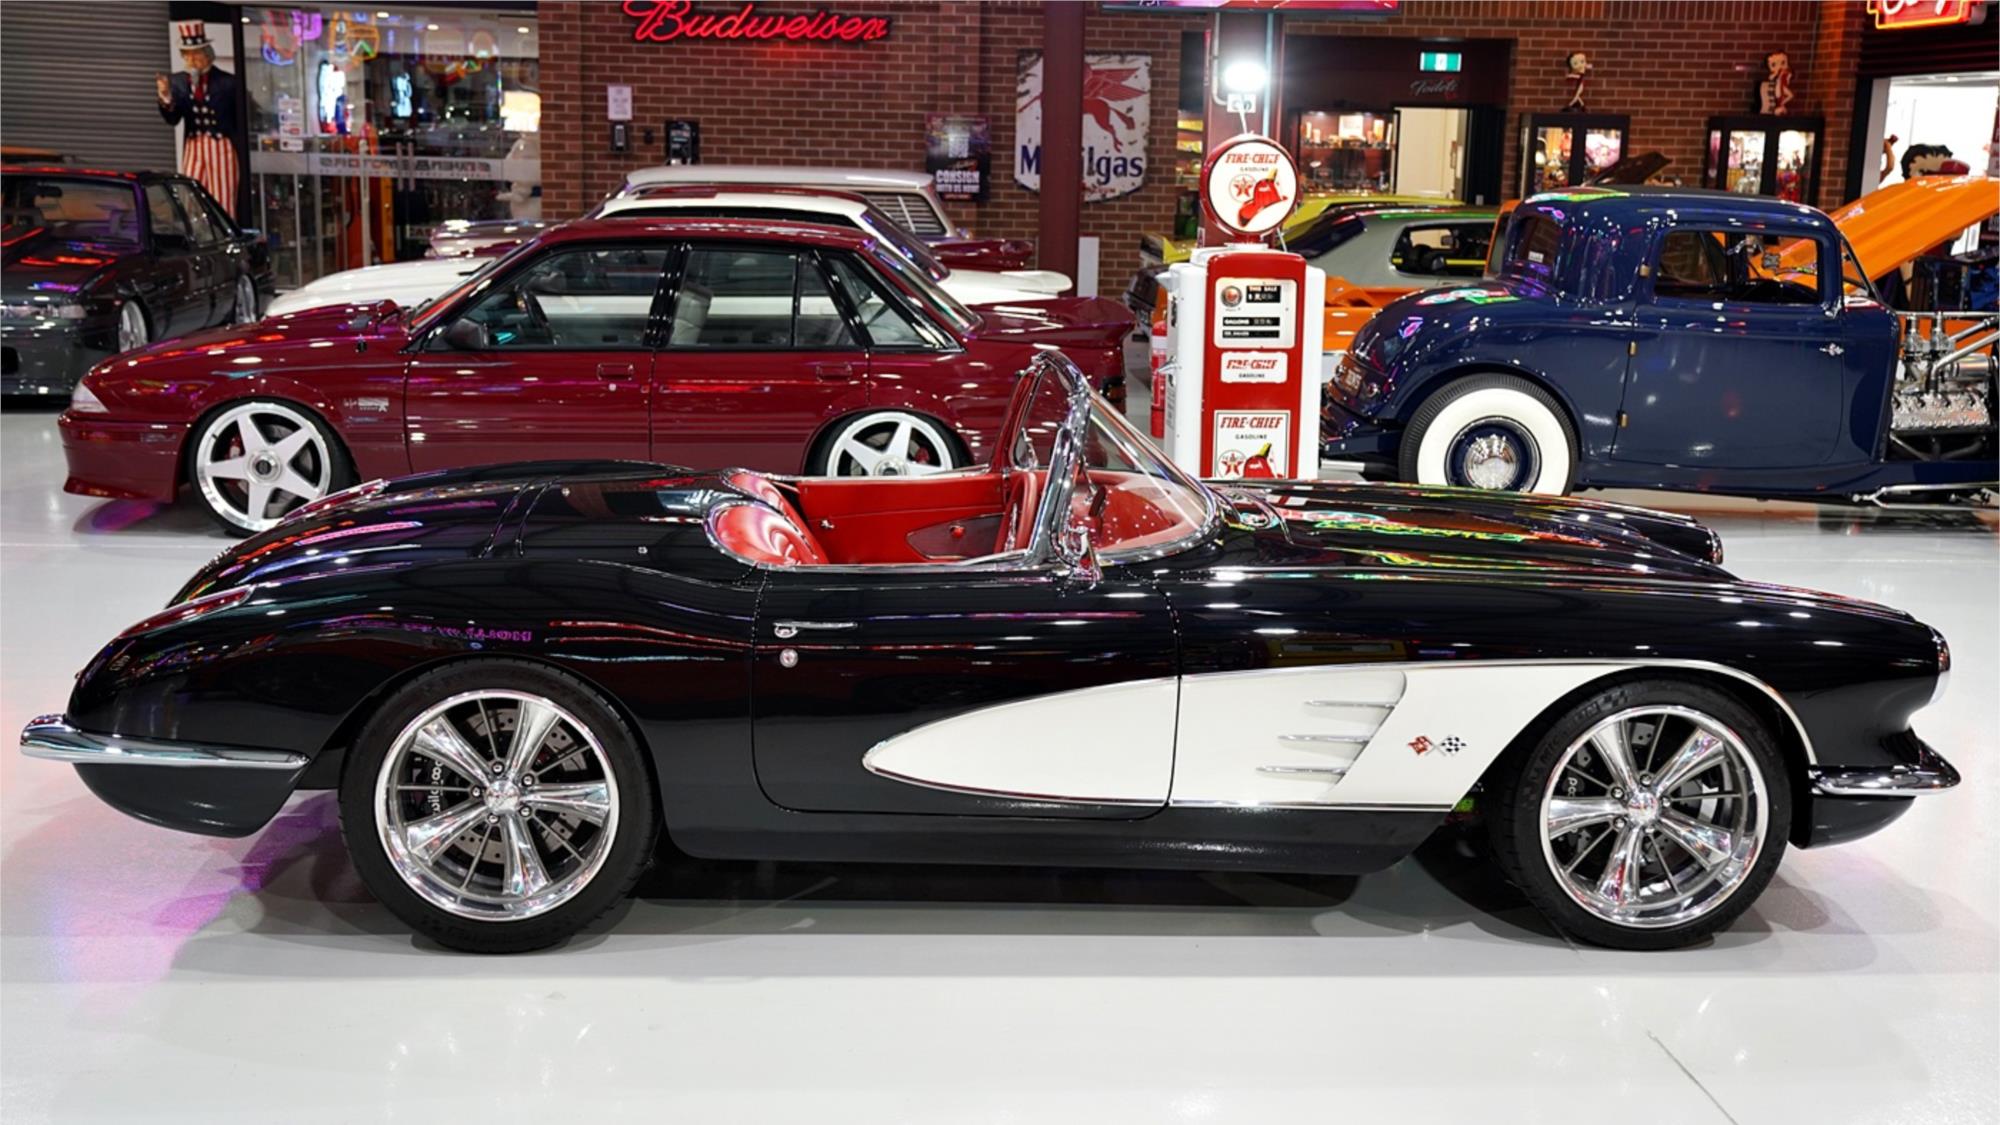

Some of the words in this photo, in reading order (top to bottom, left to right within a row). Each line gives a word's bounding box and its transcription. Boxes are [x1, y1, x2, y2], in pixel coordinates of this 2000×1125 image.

[623, 0, 887, 41] Budweiser
[936, 169, 980, 183] CONSIGN
[1220, 416, 1283, 429] FIRE-CHIEF
